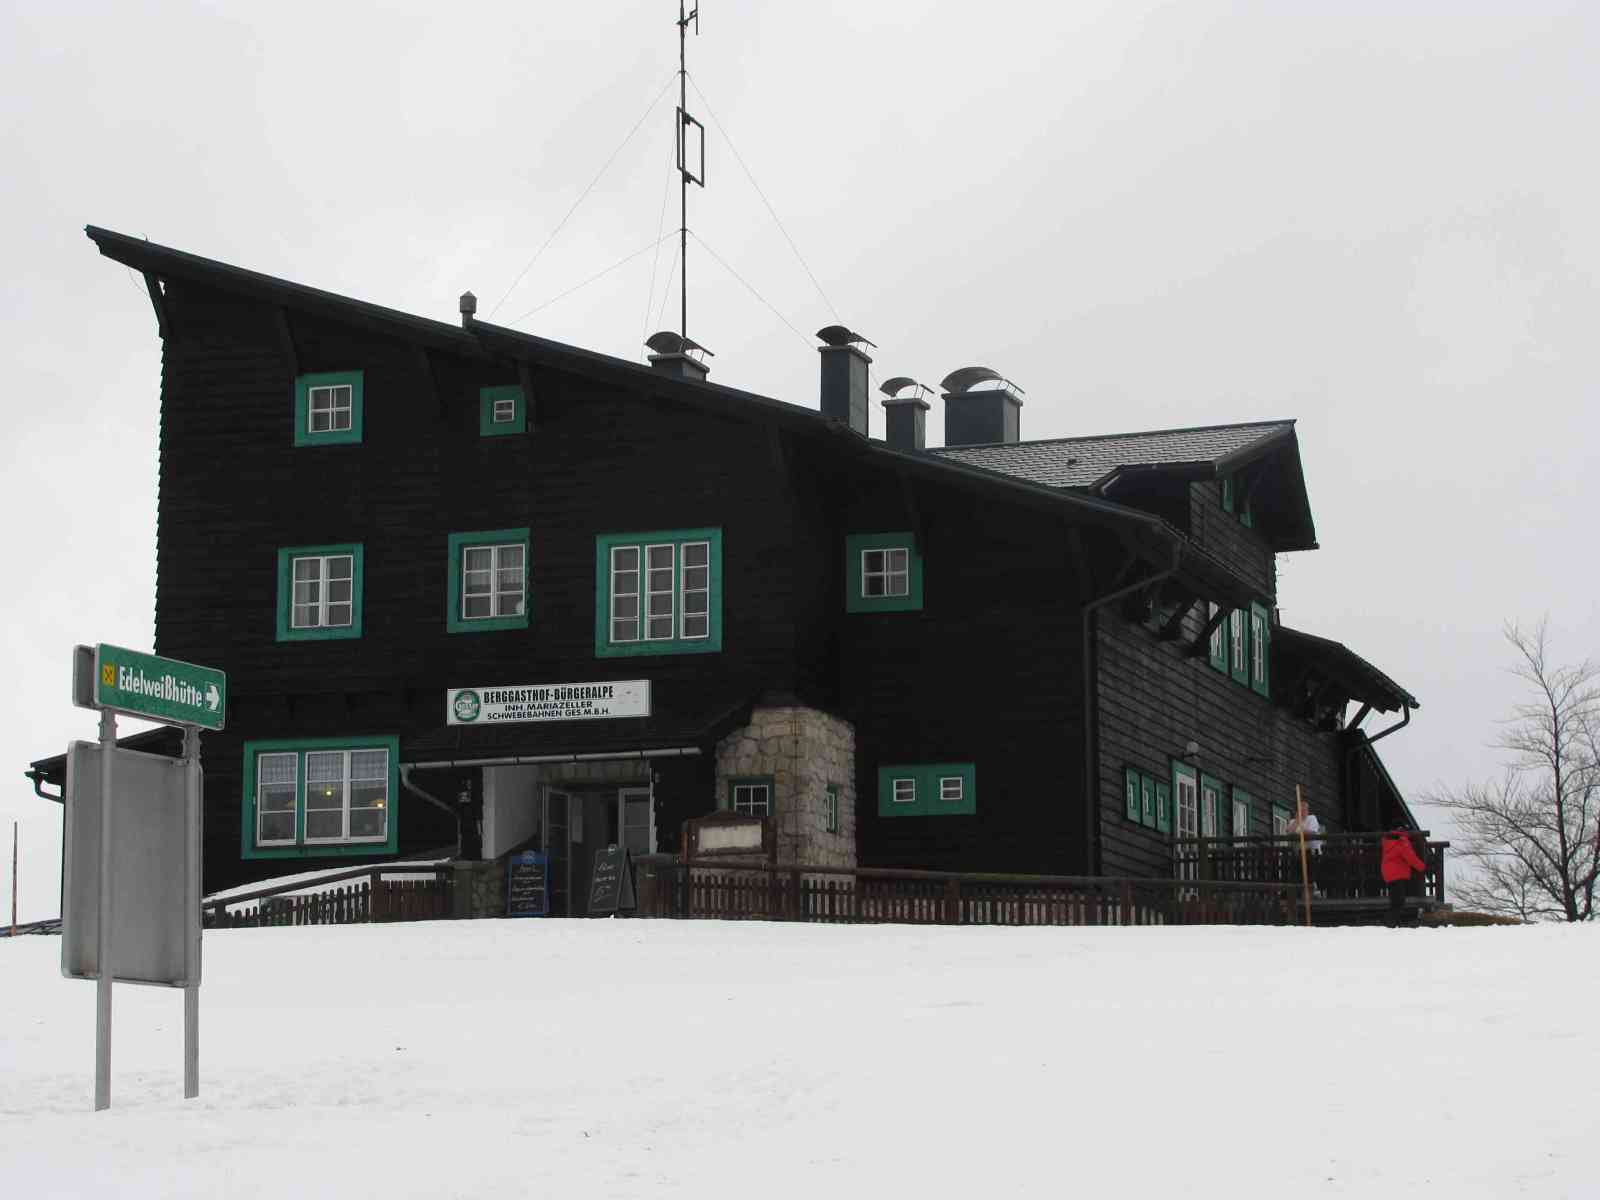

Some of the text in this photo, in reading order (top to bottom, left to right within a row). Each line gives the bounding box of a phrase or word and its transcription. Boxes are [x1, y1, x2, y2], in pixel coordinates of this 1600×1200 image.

[119, 665, 203, 708] Edelweißhütte
[526, 700, 593, 711] MARIAZELLER
[487, 709, 562, 720] SCHWEBEBAHNEN
